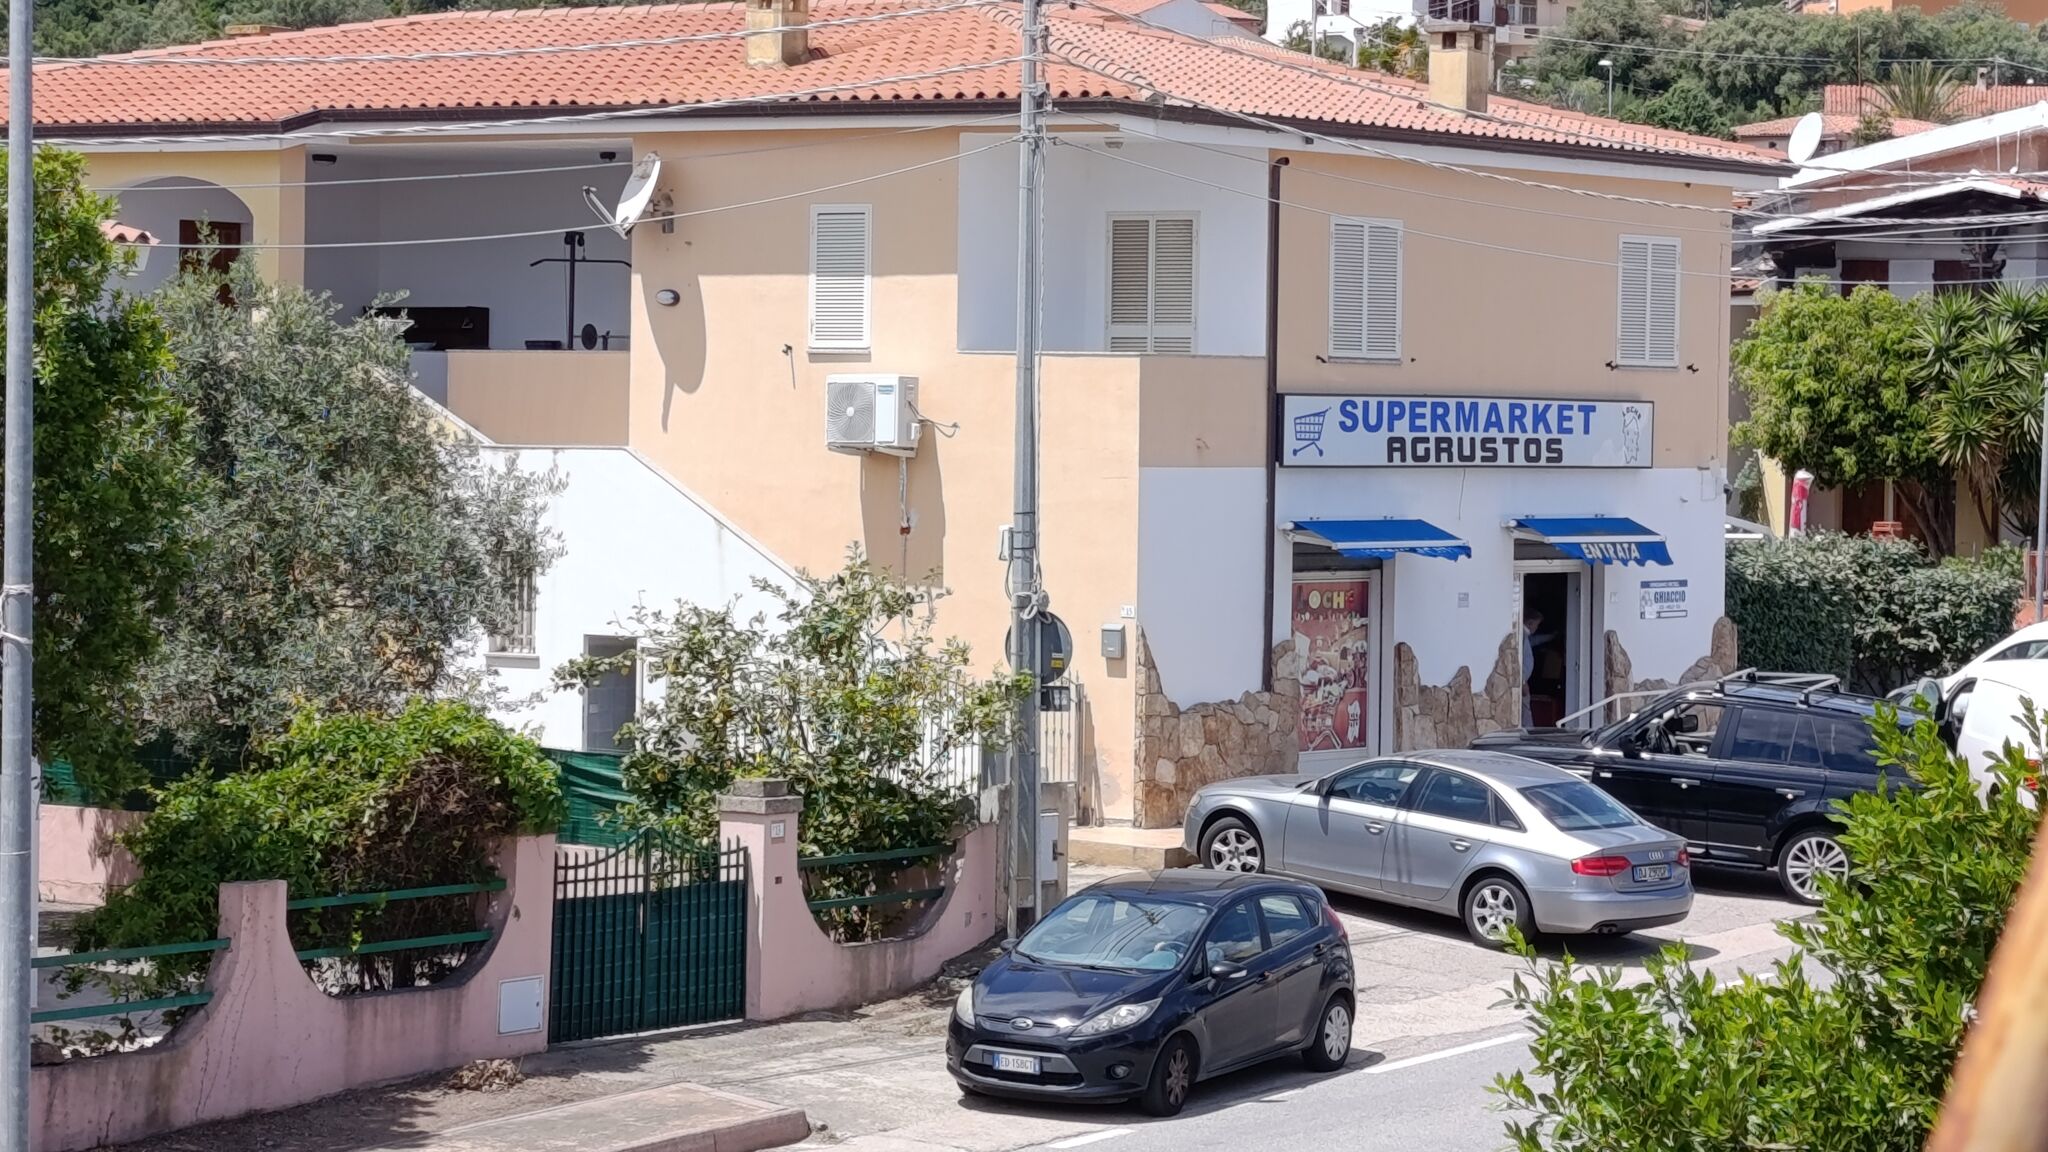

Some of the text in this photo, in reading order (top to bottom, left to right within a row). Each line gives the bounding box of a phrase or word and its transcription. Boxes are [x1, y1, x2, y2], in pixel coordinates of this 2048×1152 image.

[1338, 399, 1597, 436] SUPERMARKET
[1386, 436, 1564, 464] AGRUSTOS
[1580, 542, 1641, 560] ENTRATA
[1654, 590, 1686, 604] GHIACCIO
